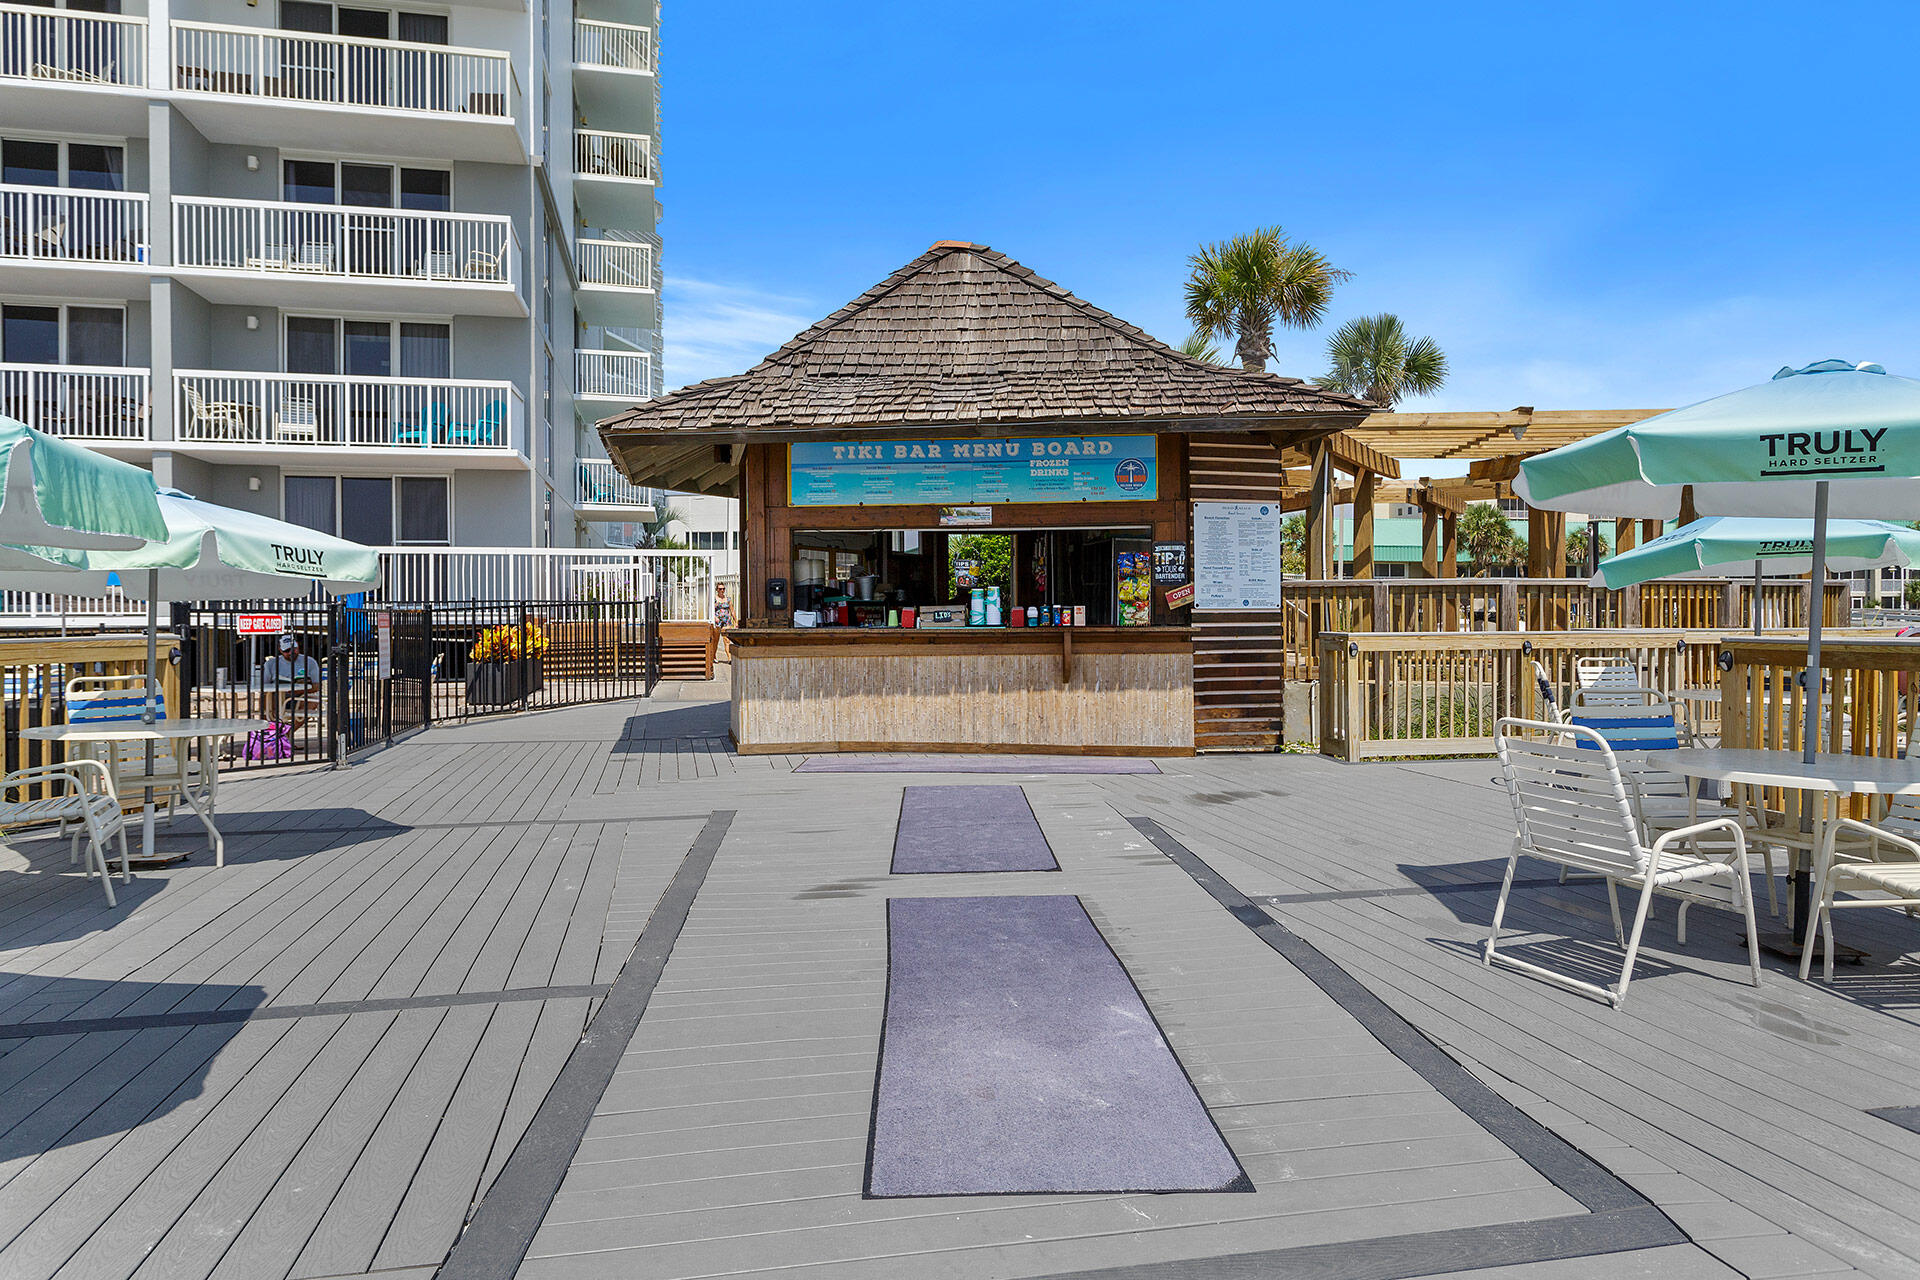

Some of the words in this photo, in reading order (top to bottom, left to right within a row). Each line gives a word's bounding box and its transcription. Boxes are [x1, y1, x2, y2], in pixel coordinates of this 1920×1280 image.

[1760, 428, 1888, 457] TRULY
[833, 445, 883, 459] TIKI
[894, 445, 942, 458] BAR
[953, 443, 1020, 457] MENU
[1032, 441, 1113, 456] BOARD
[1030, 459, 1069, 467] FROZEN
[1769, 459, 1808, 467] HARD
[1814, 456, 1877, 465] SELTZER
[1030, 468, 1069, 477] DRINKS
[271, 543, 324, 566] TRULY
[1162, 565, 1178, 573] YOUR
[1172, 588, 1191, 600] OPEN
[240, 618, 252, 630] KEEP
[253, 618, 265, 630] GATE
[265, 618, 282, 630] CLOSED
